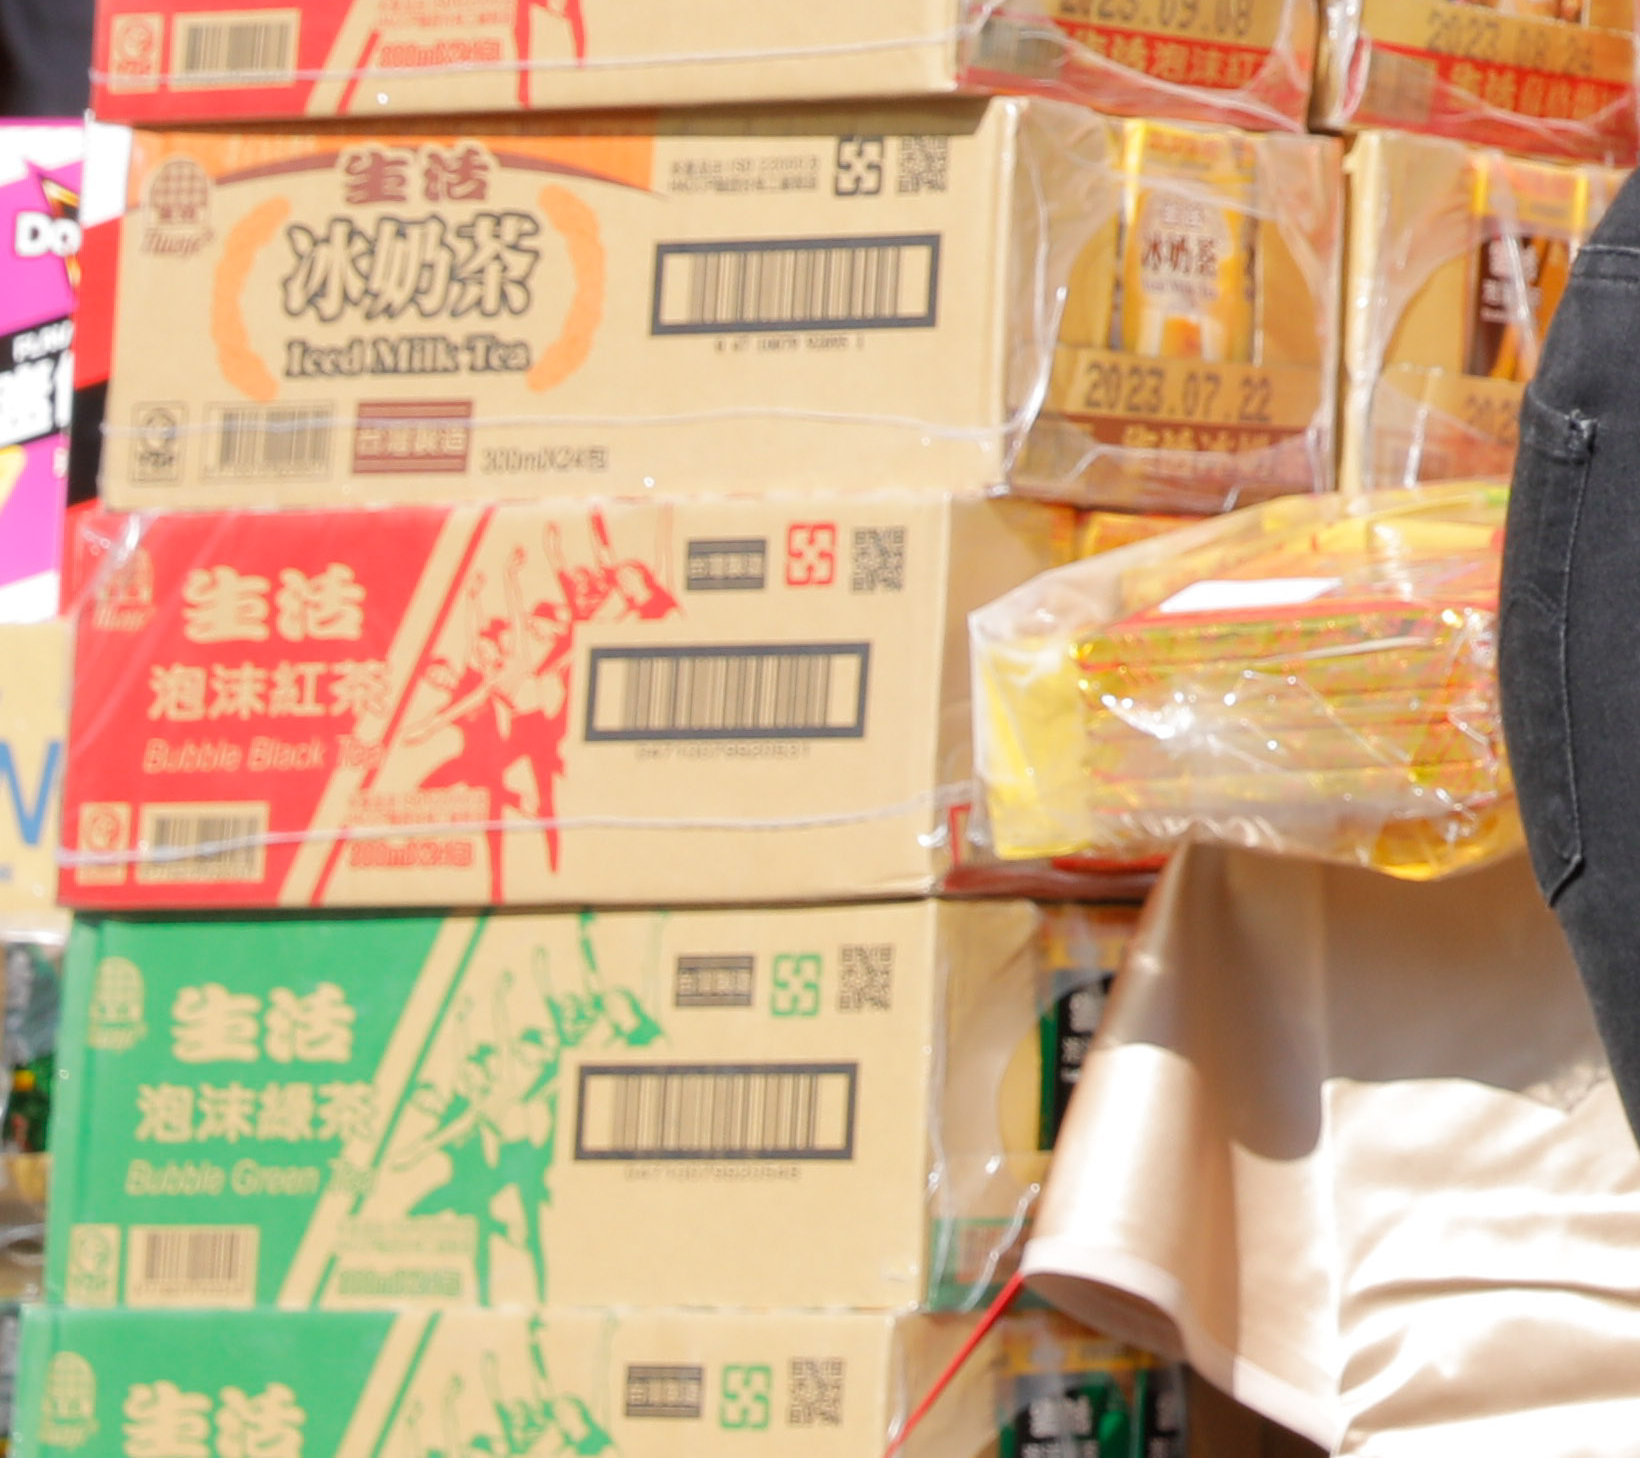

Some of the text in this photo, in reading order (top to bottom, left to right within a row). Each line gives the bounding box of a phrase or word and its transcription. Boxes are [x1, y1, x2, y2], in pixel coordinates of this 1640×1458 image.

[344, 145, 490, 205] 生活
[282, 209, 542, 323] 冰奶茶
[285, 333, 532, 378] Iced Milk Tea
[1084, 361, 1273, 423] 2023.07.22
[182, 562, 366, 644] 生活
[147, 659, 391, 722] 泡沫紅茶
[142, 733, 384, 774] Bubble Black Tea
[171, 982, 356, 1063] 生活
[134, 1081, 377, 1143] 泡沫綠茶
[125, 1158, 226, 1196] Bubble
[231, 1157, 320, 1196] Green
[123, 1381, 306, 1458] 生活
